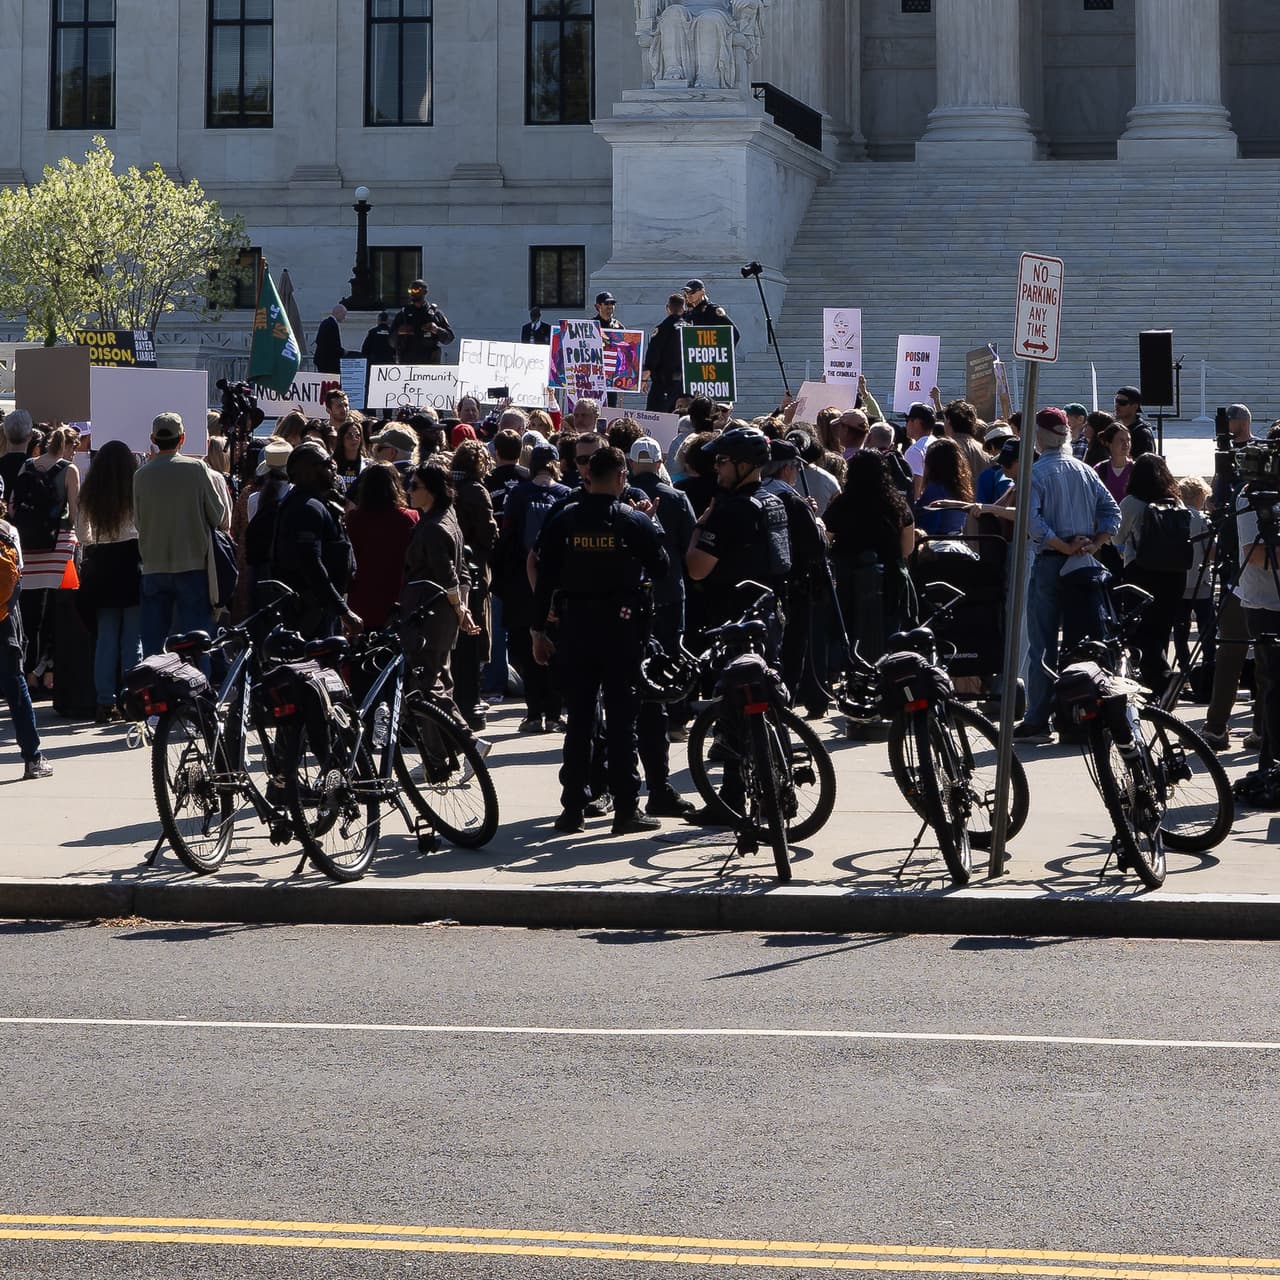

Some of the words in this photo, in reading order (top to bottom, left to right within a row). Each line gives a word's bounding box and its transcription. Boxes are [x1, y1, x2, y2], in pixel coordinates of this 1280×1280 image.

[1033, 264, 1049, 284] NO
[1022, 285, 1057, 306] PARKING
[1029, 306, 1048, 322] ANY
[76, 332, 116, 345] YOUR
[568, 322, 596, 339] BAYER
[696, 330, 718, 346] THE
[1027, 322, 1048, 339] TIME
[90, 347, 136, 364] OISON,
[487, 341, 545, 375] Employees
[566, 347, 603, 364] POISON
[688, 347, 728, 363] PEOPLE
[905, 351, 930, 363] POISON
[377, 366, 401, 382] NO
[404, 366, 459, 387] Immunity
[701, 365, 716, 380] VS
[912, 366, 921, 377] TO
[402, 383, 422, 394] for
[690, 382, 730, 397] POISON
[908, 381, 921, 392] U.S.
[573, 535, 615, 548] POLICE
[389, 677, 404, 745] TREK
